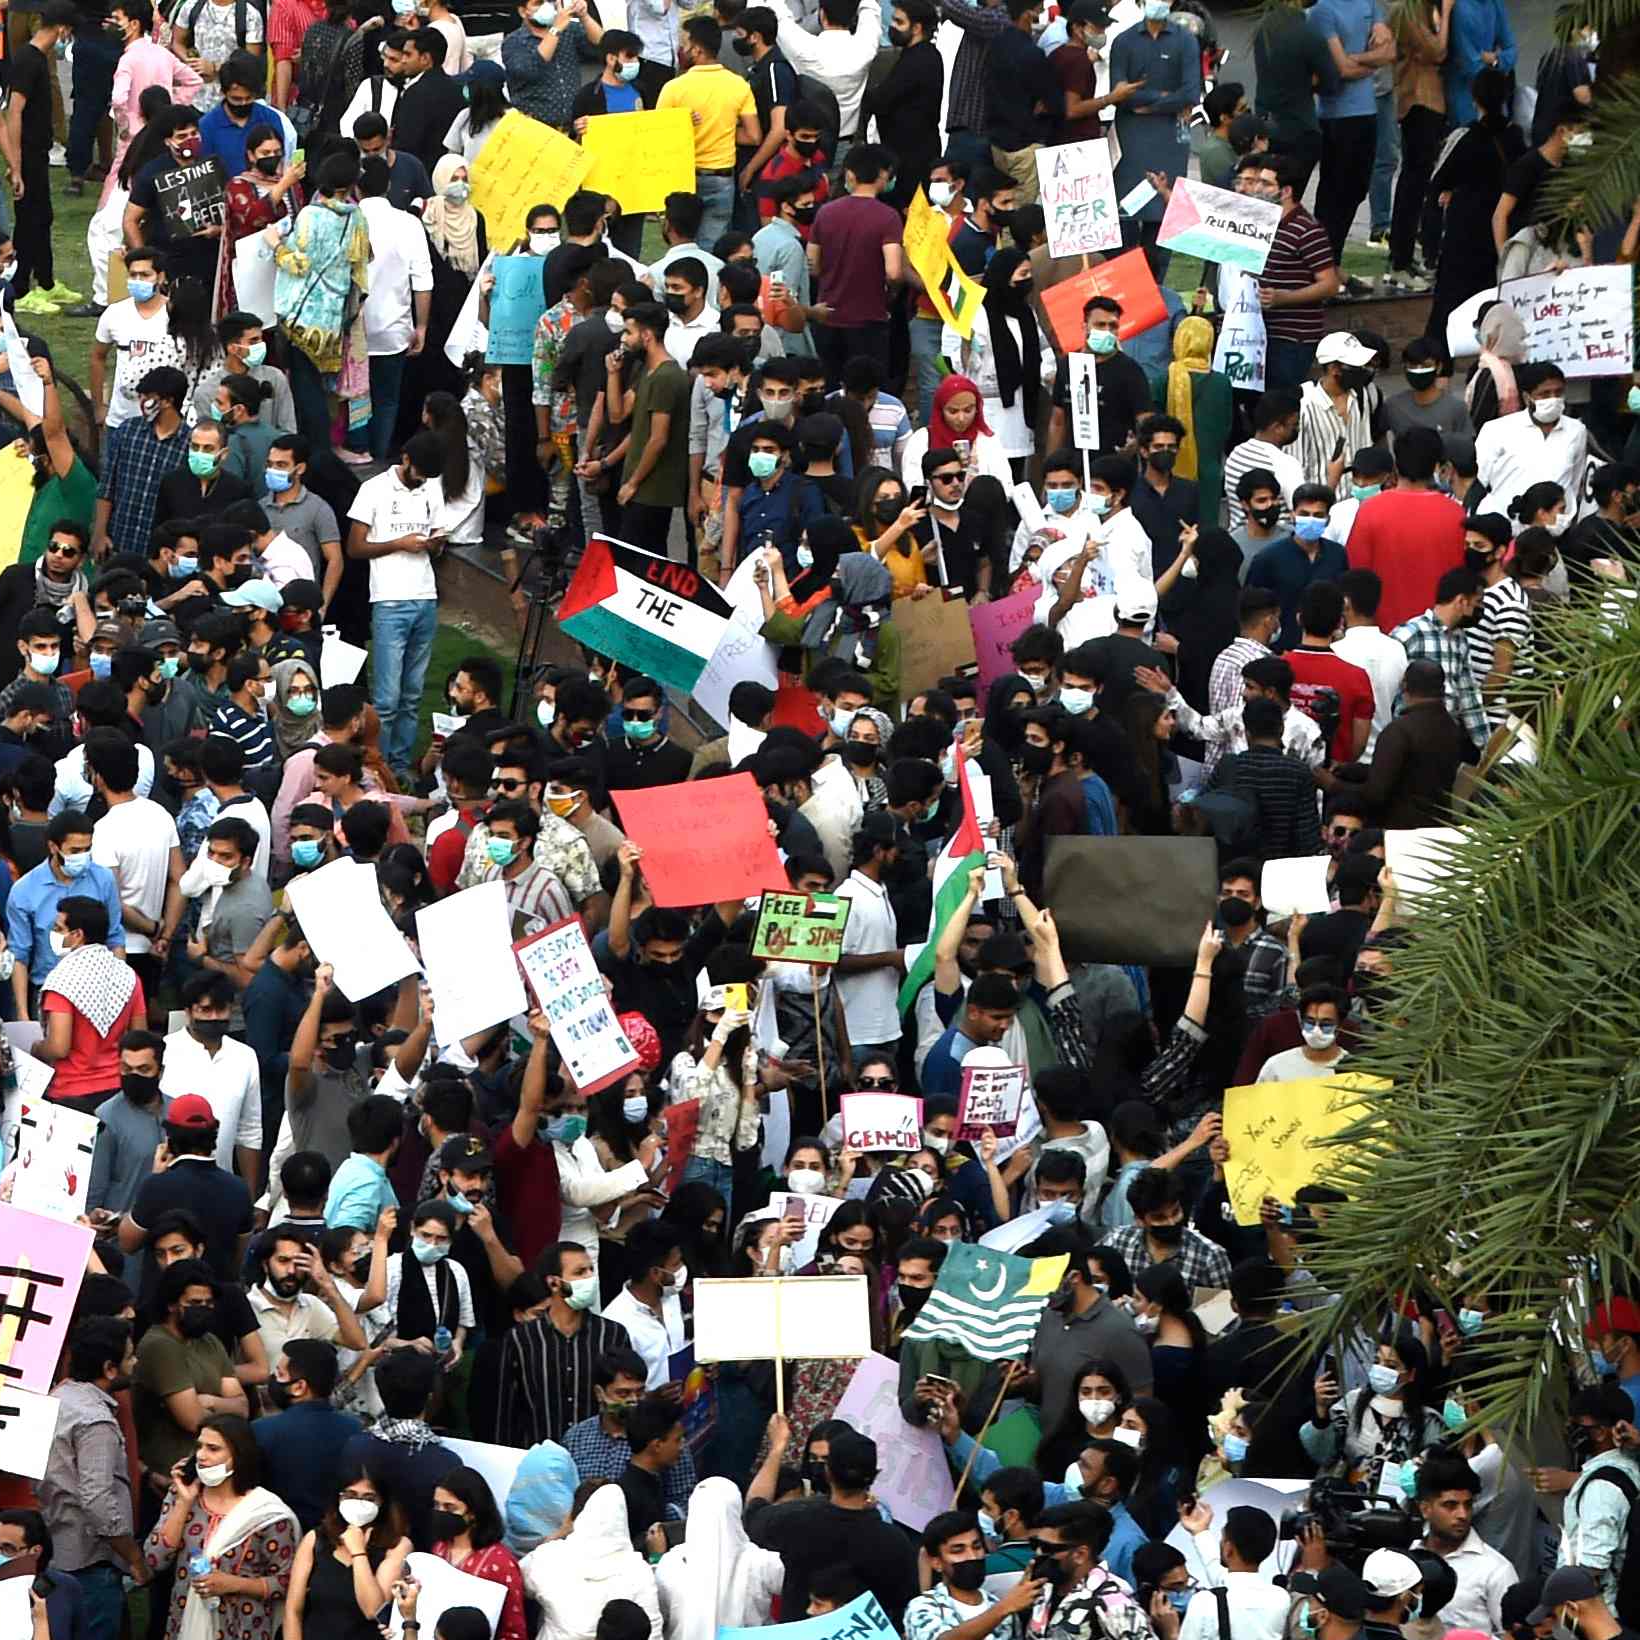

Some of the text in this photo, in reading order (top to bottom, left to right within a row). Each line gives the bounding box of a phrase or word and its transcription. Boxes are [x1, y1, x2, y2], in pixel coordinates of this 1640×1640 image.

[153, 160, 215, 193] LESTINE
[1533, 303, 1564, 321] LOVE
[646, 564, 698, 597] END
[639, 587, 683, 628] THE
[764, 898, 801, 916] FREE
[764, 922, 842, 954] PALSTINE
